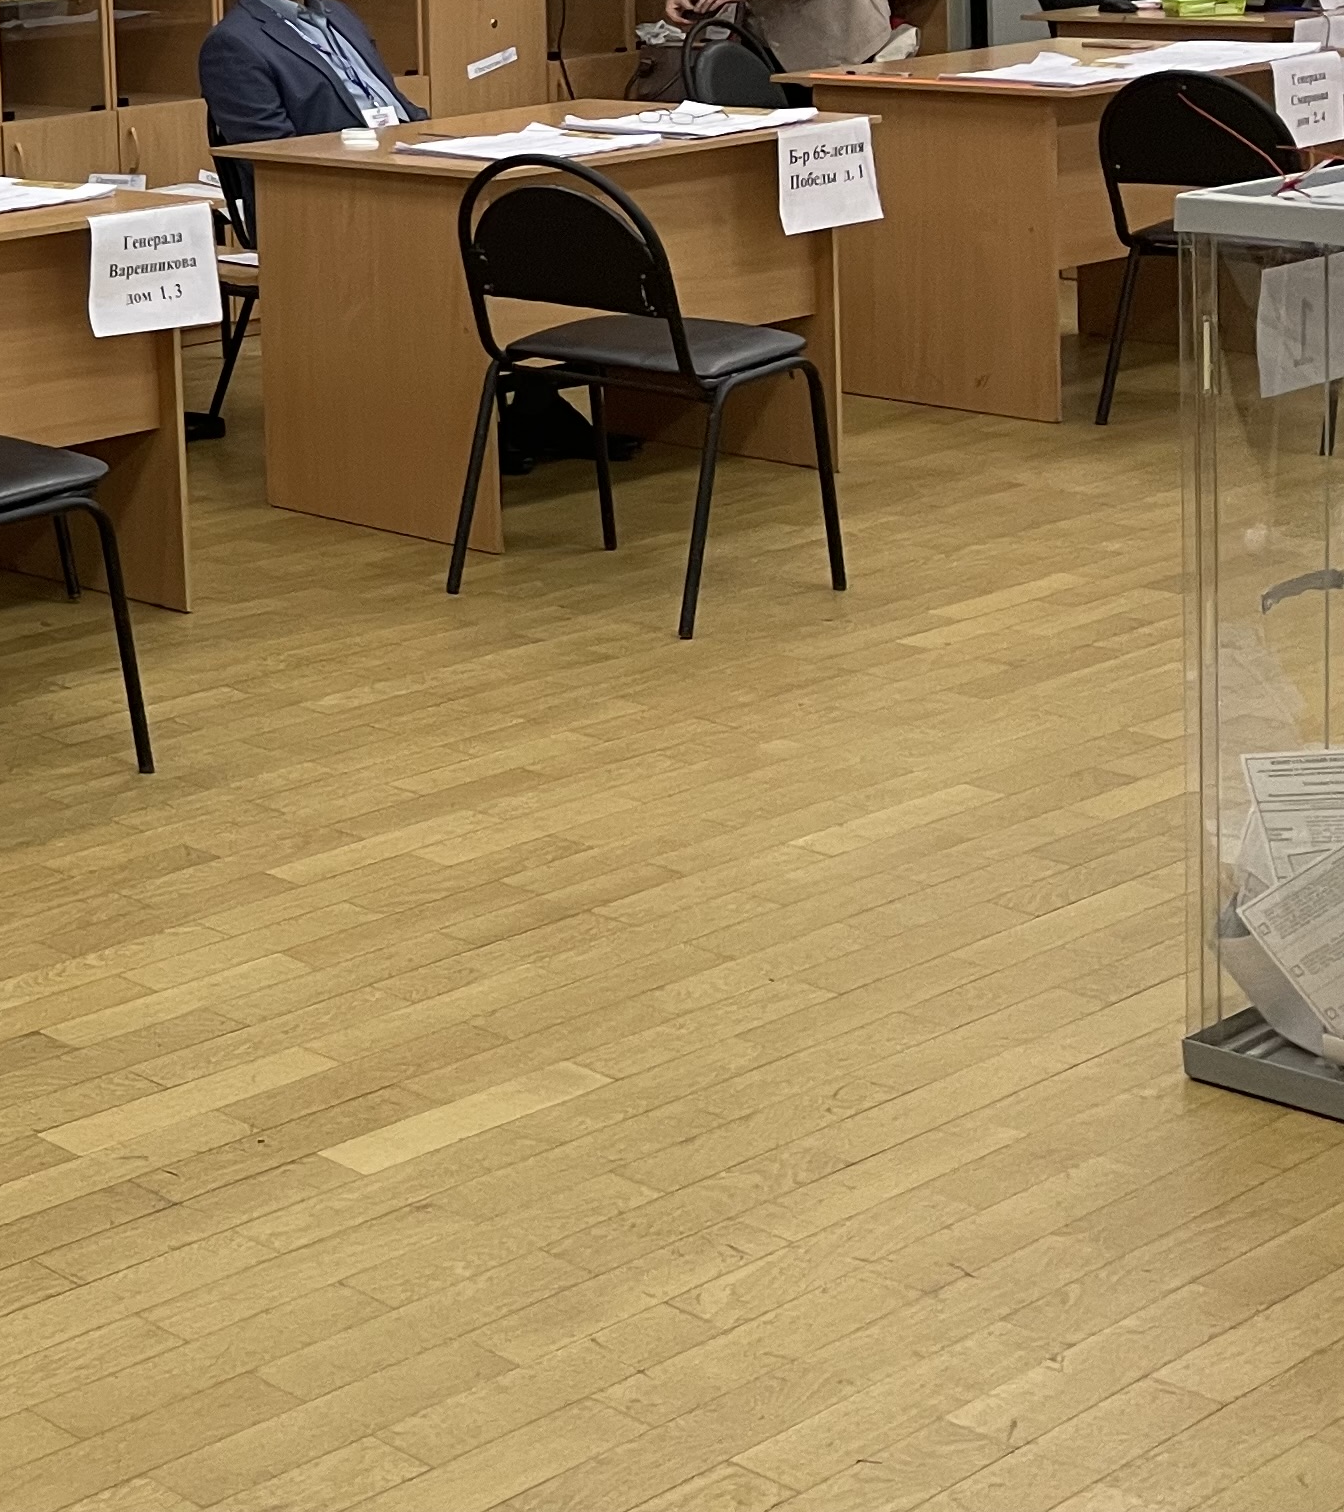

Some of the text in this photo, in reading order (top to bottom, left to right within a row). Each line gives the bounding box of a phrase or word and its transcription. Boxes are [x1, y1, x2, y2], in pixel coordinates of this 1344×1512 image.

[789, 142, 865, 167] Б-р 65-летия
[790, 171, 837, 190] Победы
[123, 232, 183, 251] Генерала
[109, 256, 198, 280] Варенникова
[125, 291, 153, 306] дом
